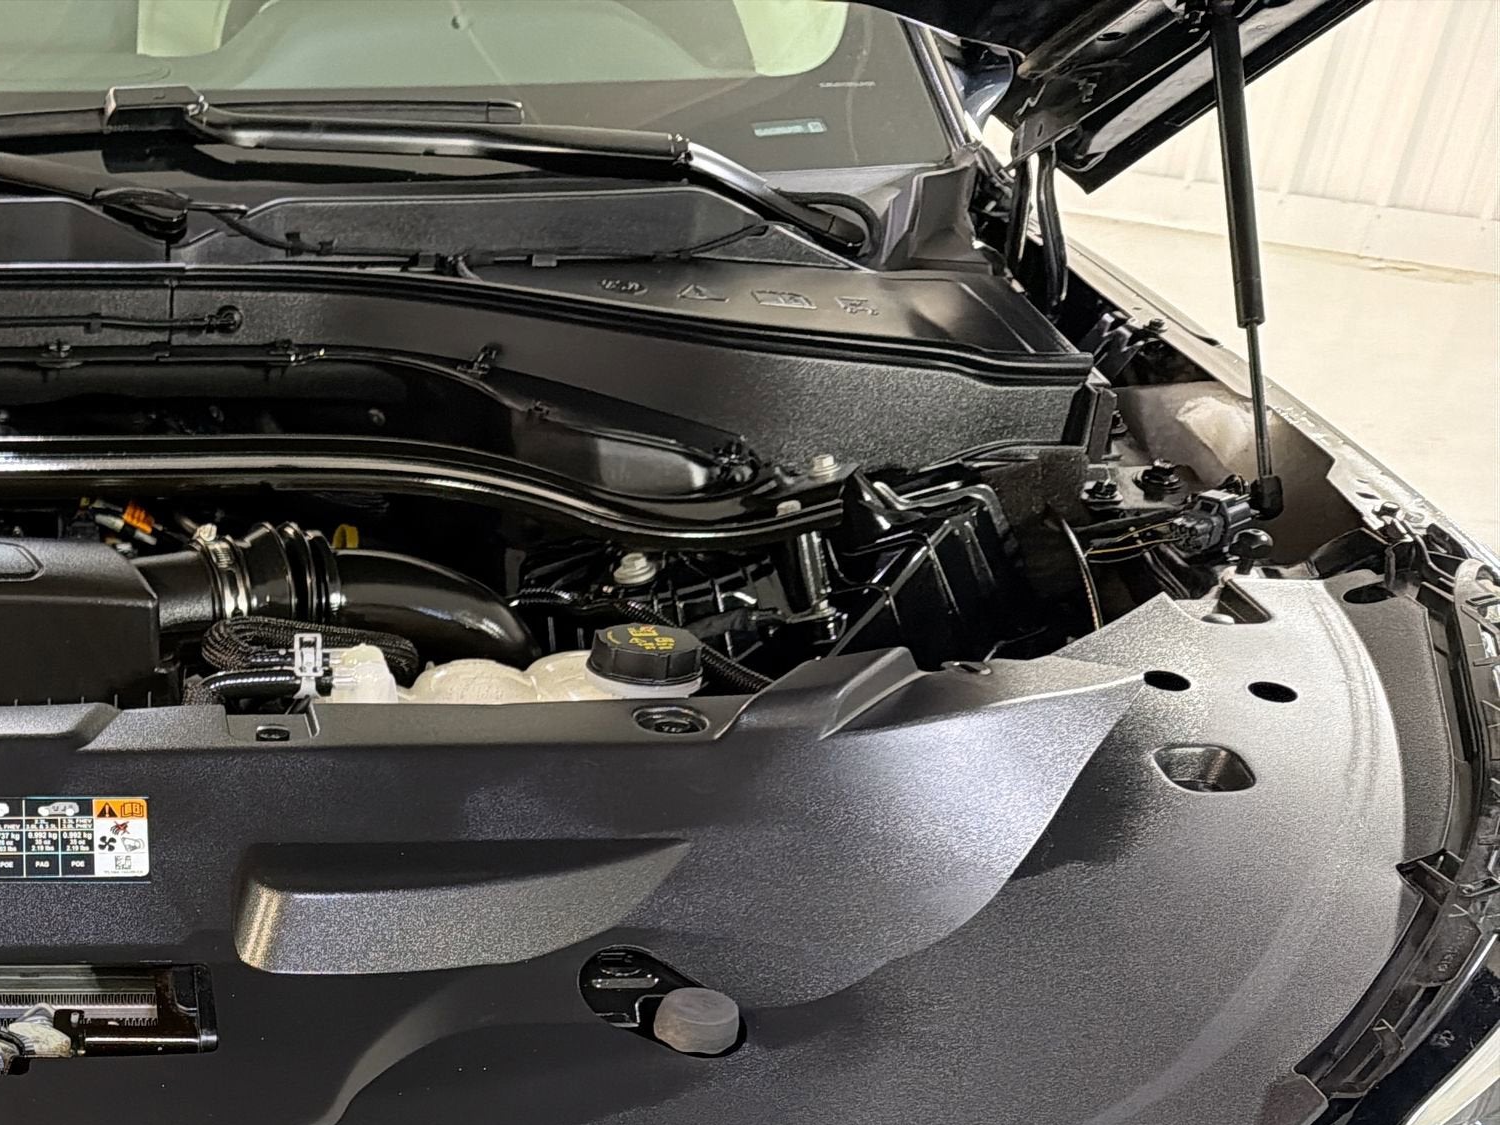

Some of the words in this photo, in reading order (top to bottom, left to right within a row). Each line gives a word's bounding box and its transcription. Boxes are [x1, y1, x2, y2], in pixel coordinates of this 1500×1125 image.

[10, 832, 20, 841] kg
[48, 832, 58, 840] kg
[83, 832, 92, 840] kg
[35, 860, 50, 868] PAG
